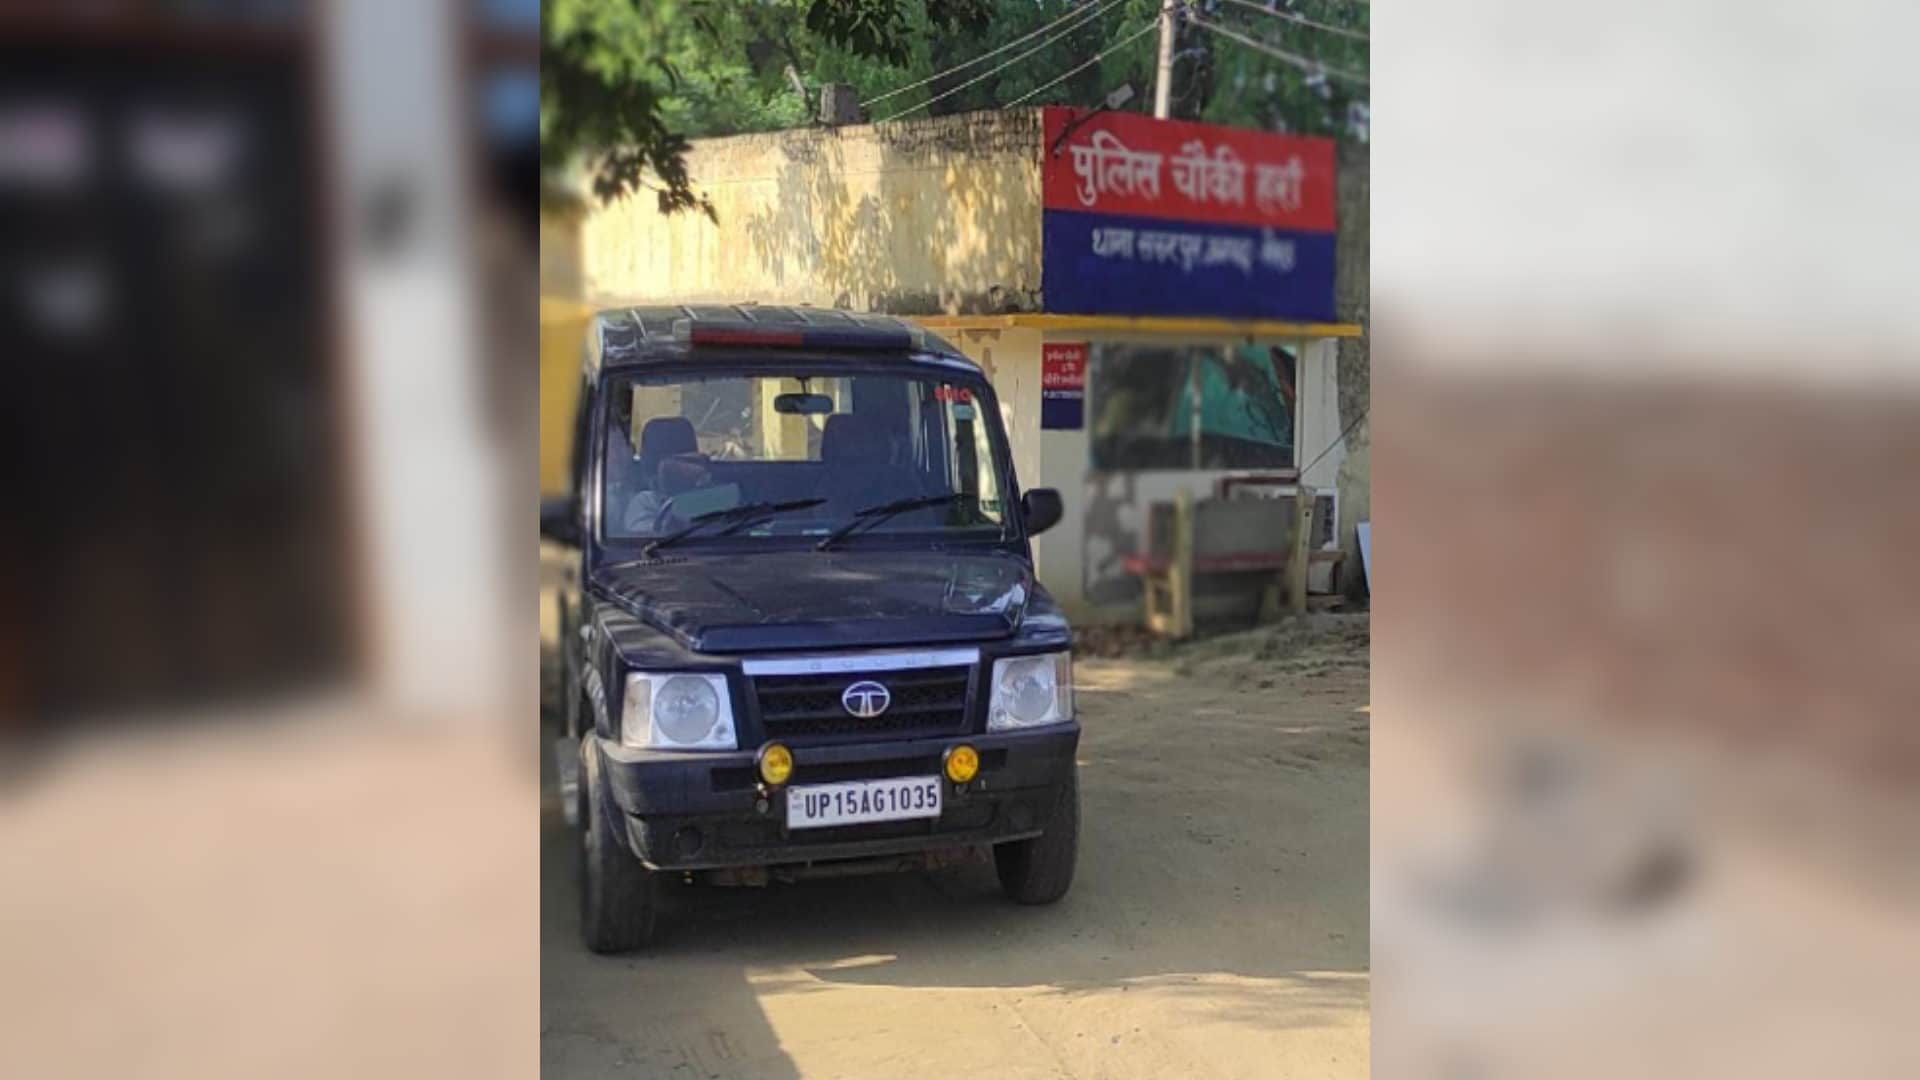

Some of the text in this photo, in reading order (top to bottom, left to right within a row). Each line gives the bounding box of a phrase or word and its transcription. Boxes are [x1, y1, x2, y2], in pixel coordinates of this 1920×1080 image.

[1069, 129, 1162, 206] पुलिस
[1170, 139, 1246, 206] चौकी
[805, 784, 938, 819] UP15AG1035
